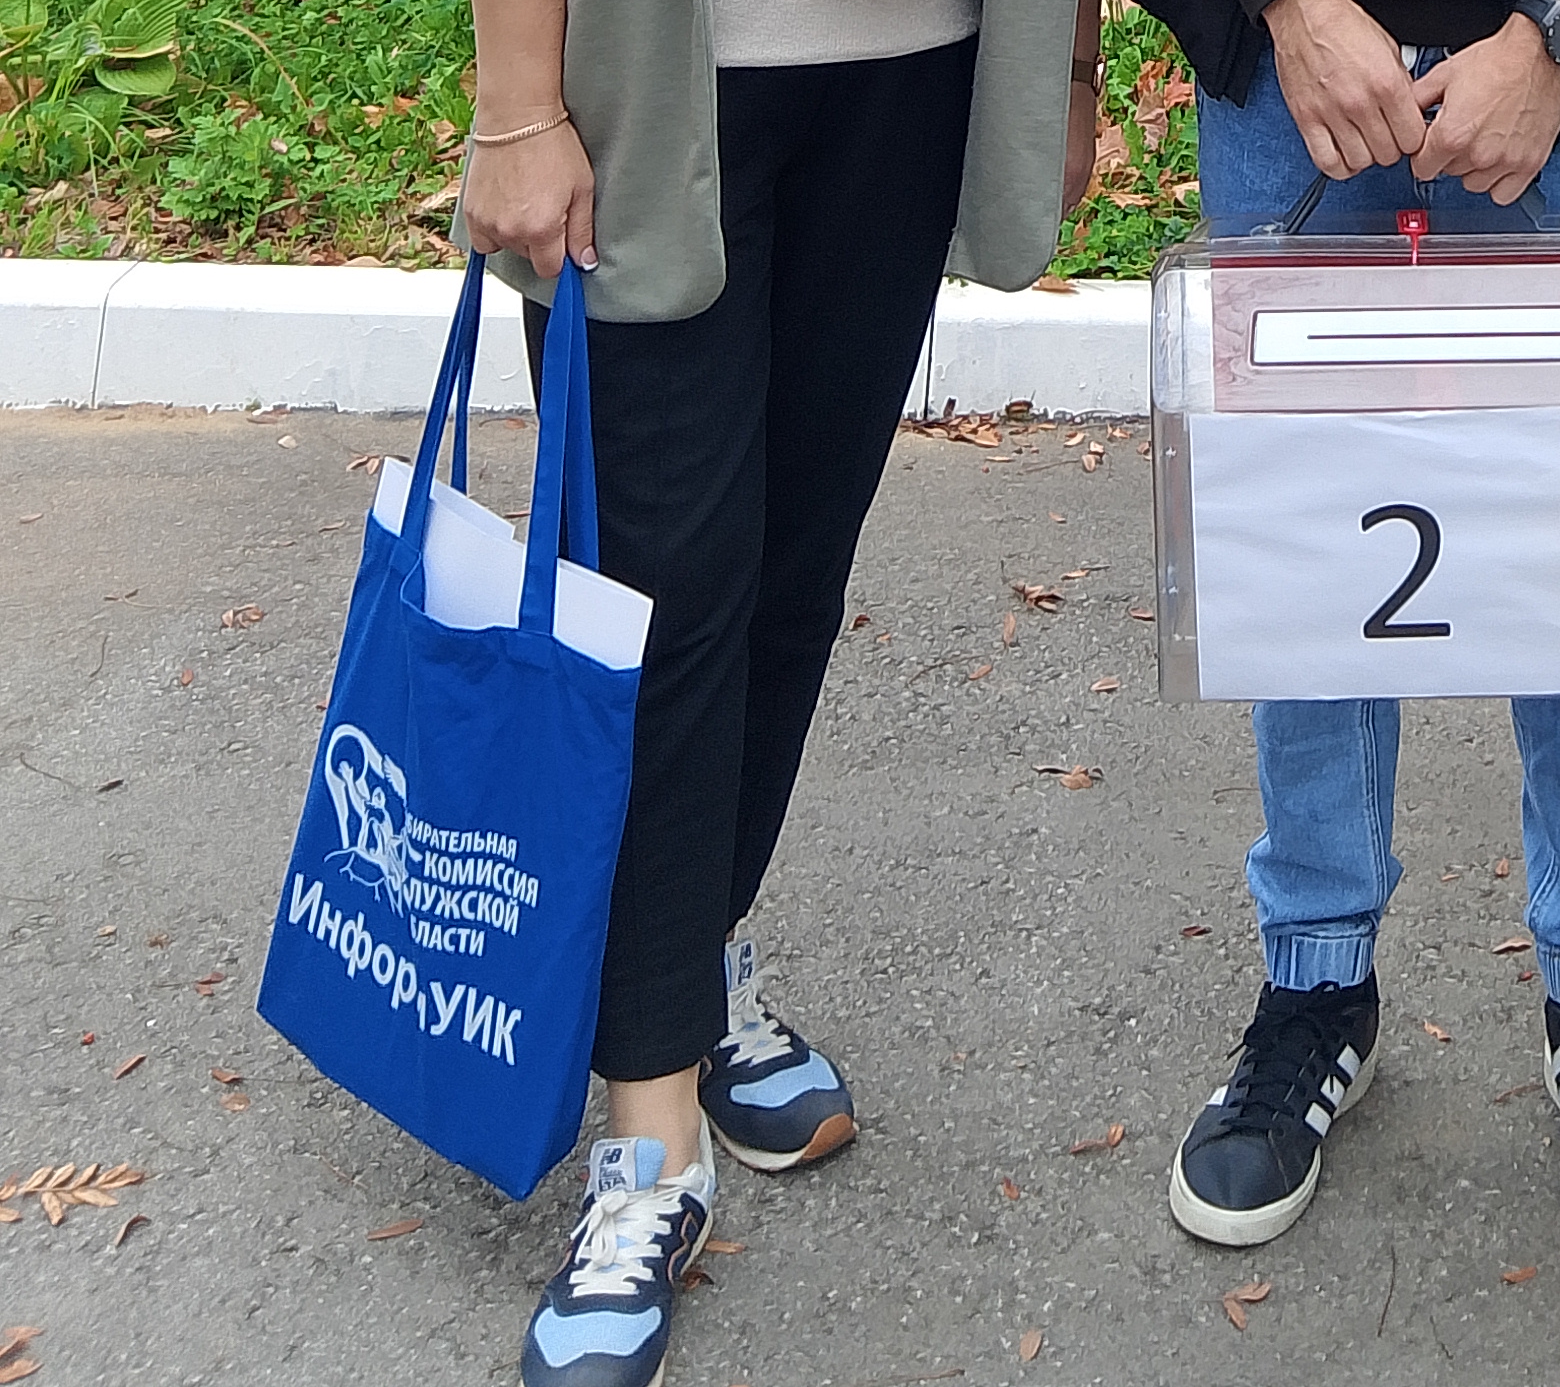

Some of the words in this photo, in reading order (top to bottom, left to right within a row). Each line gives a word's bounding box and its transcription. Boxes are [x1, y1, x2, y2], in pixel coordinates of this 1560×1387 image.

[1361, 503, 1451, 639] 2
[424, 850, 539, 908] КОМИССИЯ
[288, 873, 523, 1066] ИнфорУИК
